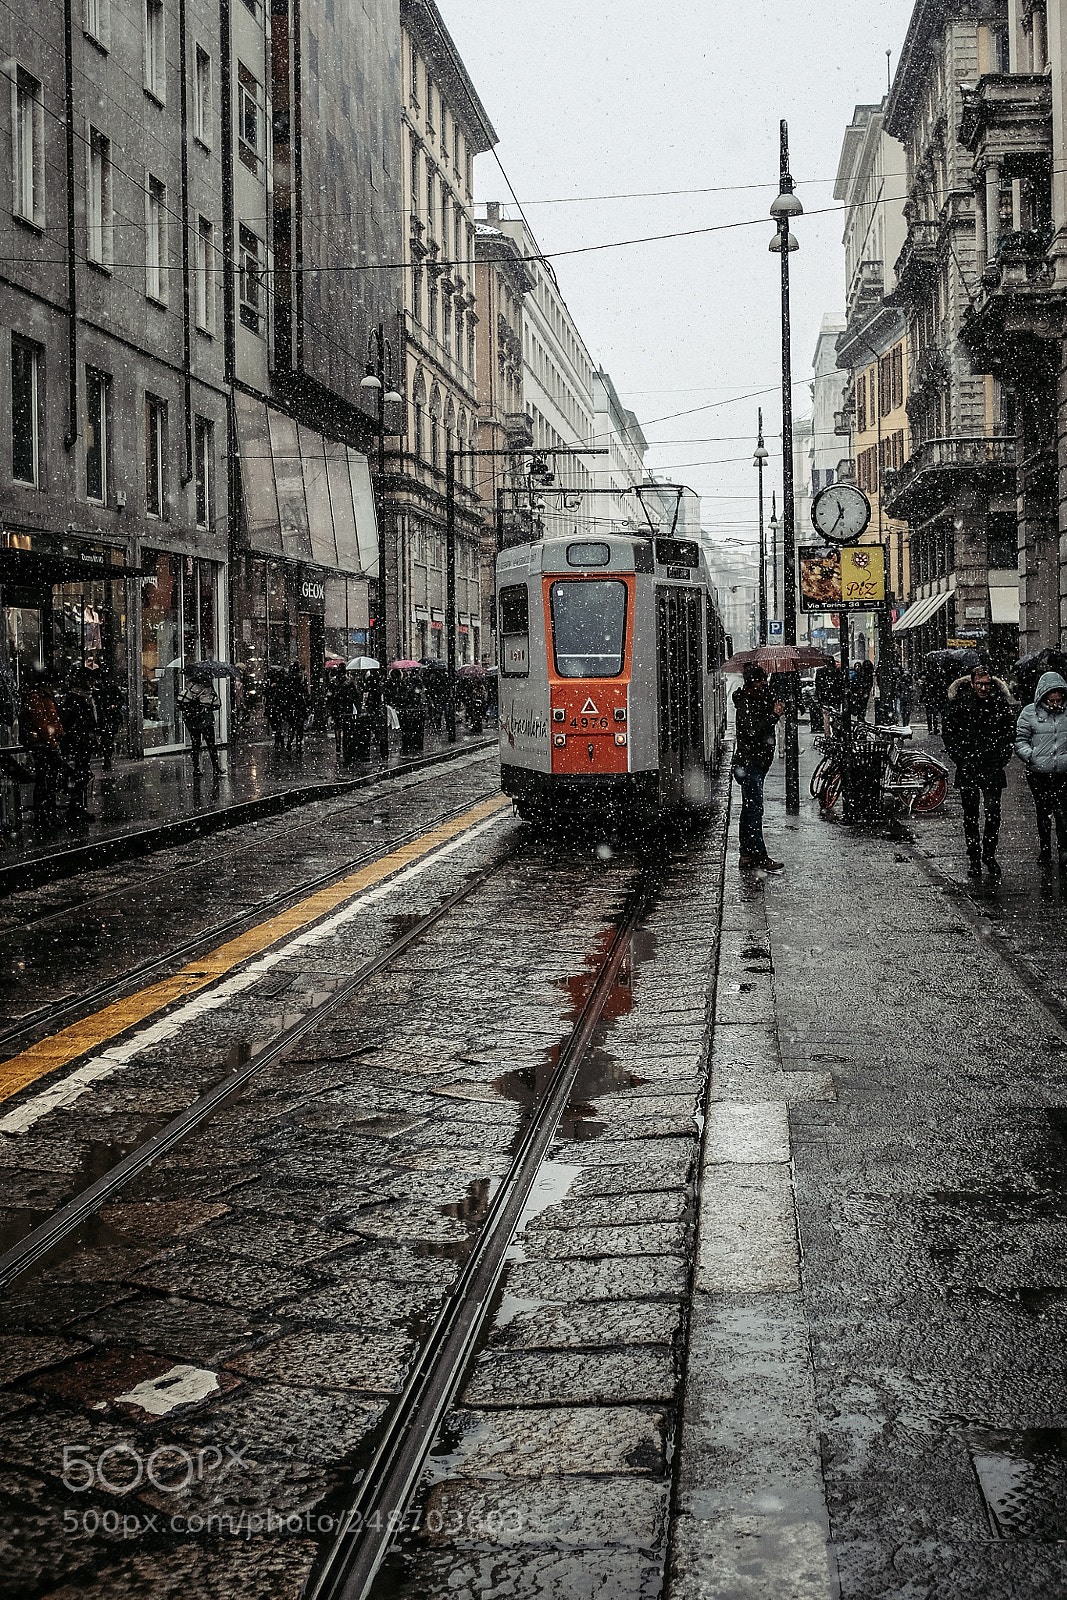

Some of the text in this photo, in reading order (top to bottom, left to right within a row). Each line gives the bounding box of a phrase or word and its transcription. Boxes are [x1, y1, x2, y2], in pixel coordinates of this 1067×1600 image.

[302, 581, 325, 600] GEOX
[807, 602, 820, 610] Via
[822, 601, 846, 609] Torino
[770, 622, 780, 634] P
[569, 716, 609, 729] 4976
